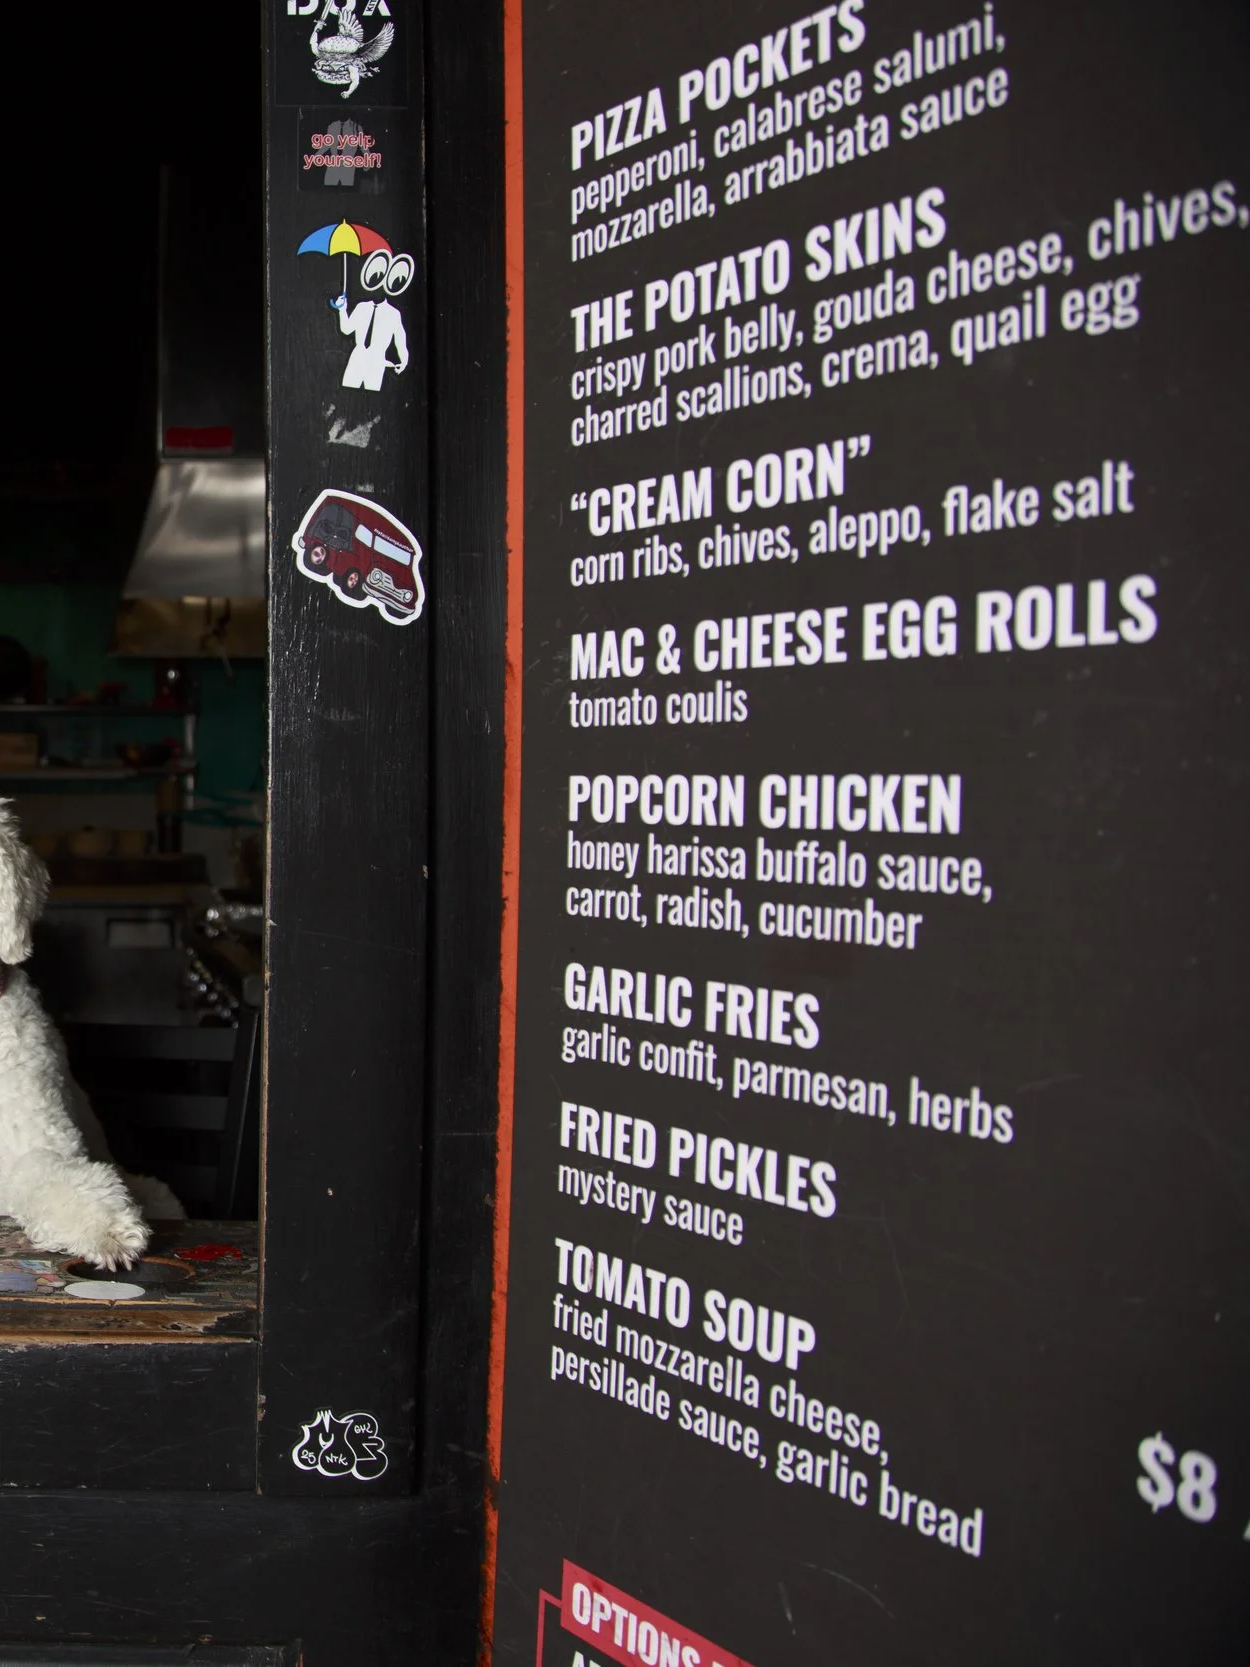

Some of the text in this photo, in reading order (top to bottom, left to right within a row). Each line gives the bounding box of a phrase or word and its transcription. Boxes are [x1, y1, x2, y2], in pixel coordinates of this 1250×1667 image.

[311, 132, 375, 149] go yelp
[571, 0, 866, 172] PIZZA POCKETS
[571, 1, 1006, 225] pepperoni, calabrese salumi,
[303, 153, 382, 169] yourself!
[571, 67, 1009, 263] mozzarella, arrabbiata sauce
[570, 186, 947, 354] THE POTATO SKINS
[570, 182, 1249, 401] crispy pork belly, gouda cheese, chives,
[570, 274, 1141, 447] charred scallions, crema, quail egg
[570, 434, 871, 537] “CREAM CORN”
[570, 459, 1135, 587] corn ribs, chives, aleppo, flake salt
[570, 574, 1158, 681] MAC & CHEESE EGG ROLLS
[568, 679, 749, 729] tomato coulis
[568, 773, 962, 835] POPCORN CHICKEN
[565, 883, 924, 950] carrot, radish, cucumber
[566, 829, 993, 904] honey harissa buffalo sauce,
[563, 962, 820, 1050] GARLIC FRIES
[560, 1022, 1014, 1144] garlic confit, parmesan, herbs
[557, 1164, 744, 1246] mystery sauce
[559, 1100, 837, 1218] FRIED PICKLES
[554, 1237, 816, 1371] TOMATO SOUP
[552, 1292, 889, 1466] fried mozzarella cheese,
[550, 1344, 983, 1558] persillade sauce, garlic bread
[1136, 1432, 1217, 1522] $8
